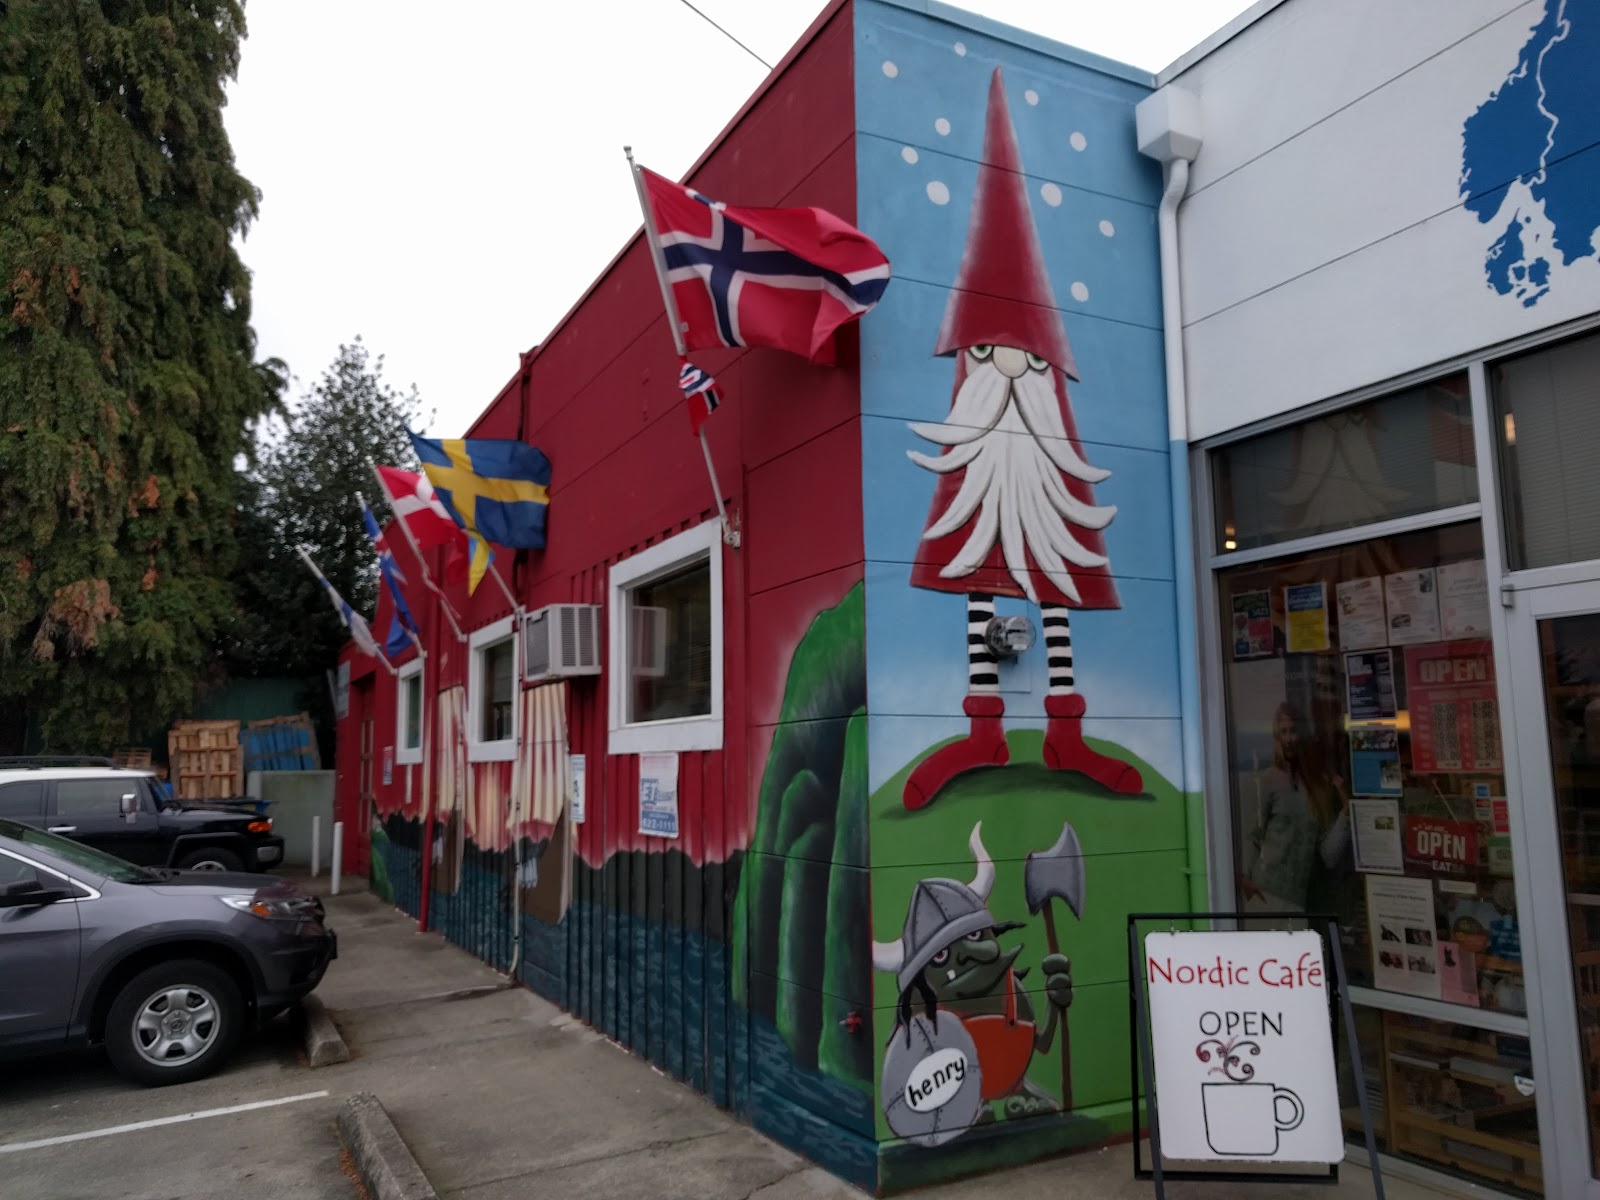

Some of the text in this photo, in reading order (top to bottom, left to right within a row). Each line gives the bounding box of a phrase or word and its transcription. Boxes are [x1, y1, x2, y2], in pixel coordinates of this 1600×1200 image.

[1418, 658, 1487, 683] OPEN
[1417, 830, 1466, 861] OPEN
[1148, 952, 1323, 989] Nordic Café
[1199, 1011, 1283, 1037] OPEN
[907, 1056, 966, 1107] henry
